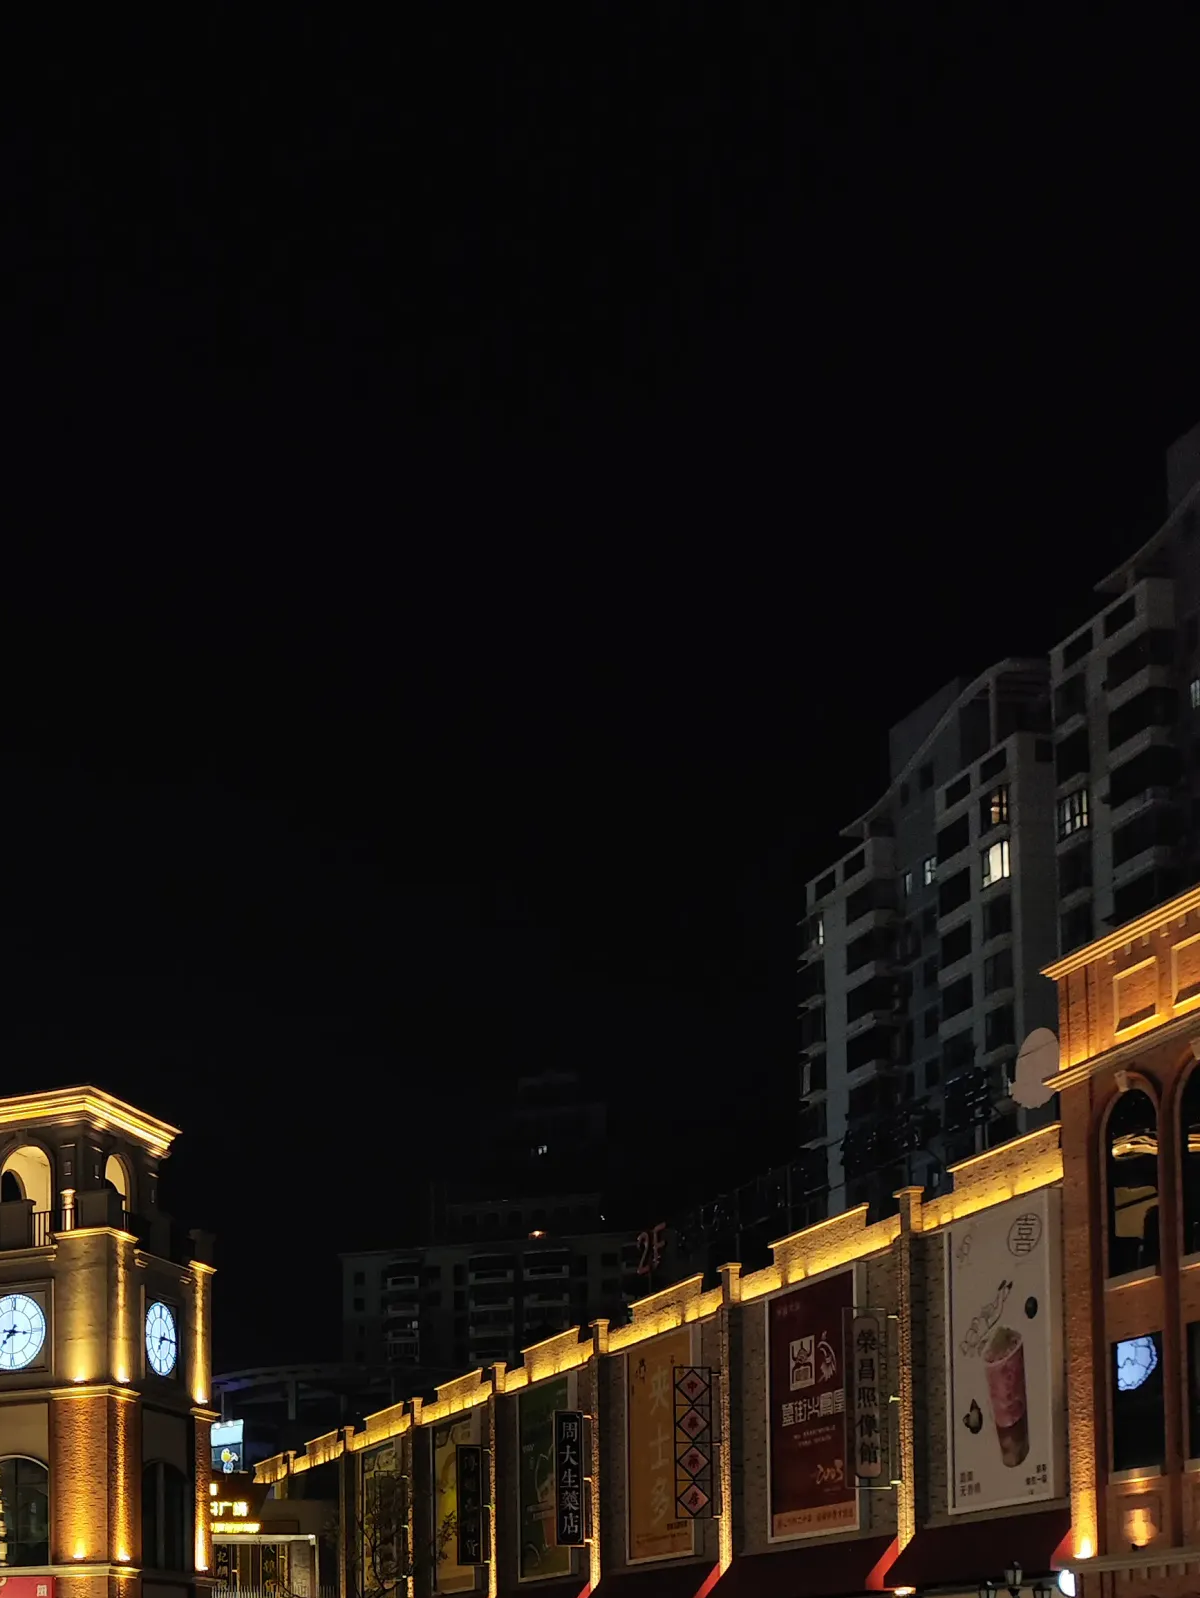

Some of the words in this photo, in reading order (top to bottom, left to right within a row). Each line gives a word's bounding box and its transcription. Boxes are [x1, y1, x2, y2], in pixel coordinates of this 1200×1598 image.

[1014, 1216, 1036, 1253] 喜
[559, 1419, 581, 1535] 周大生藥店
